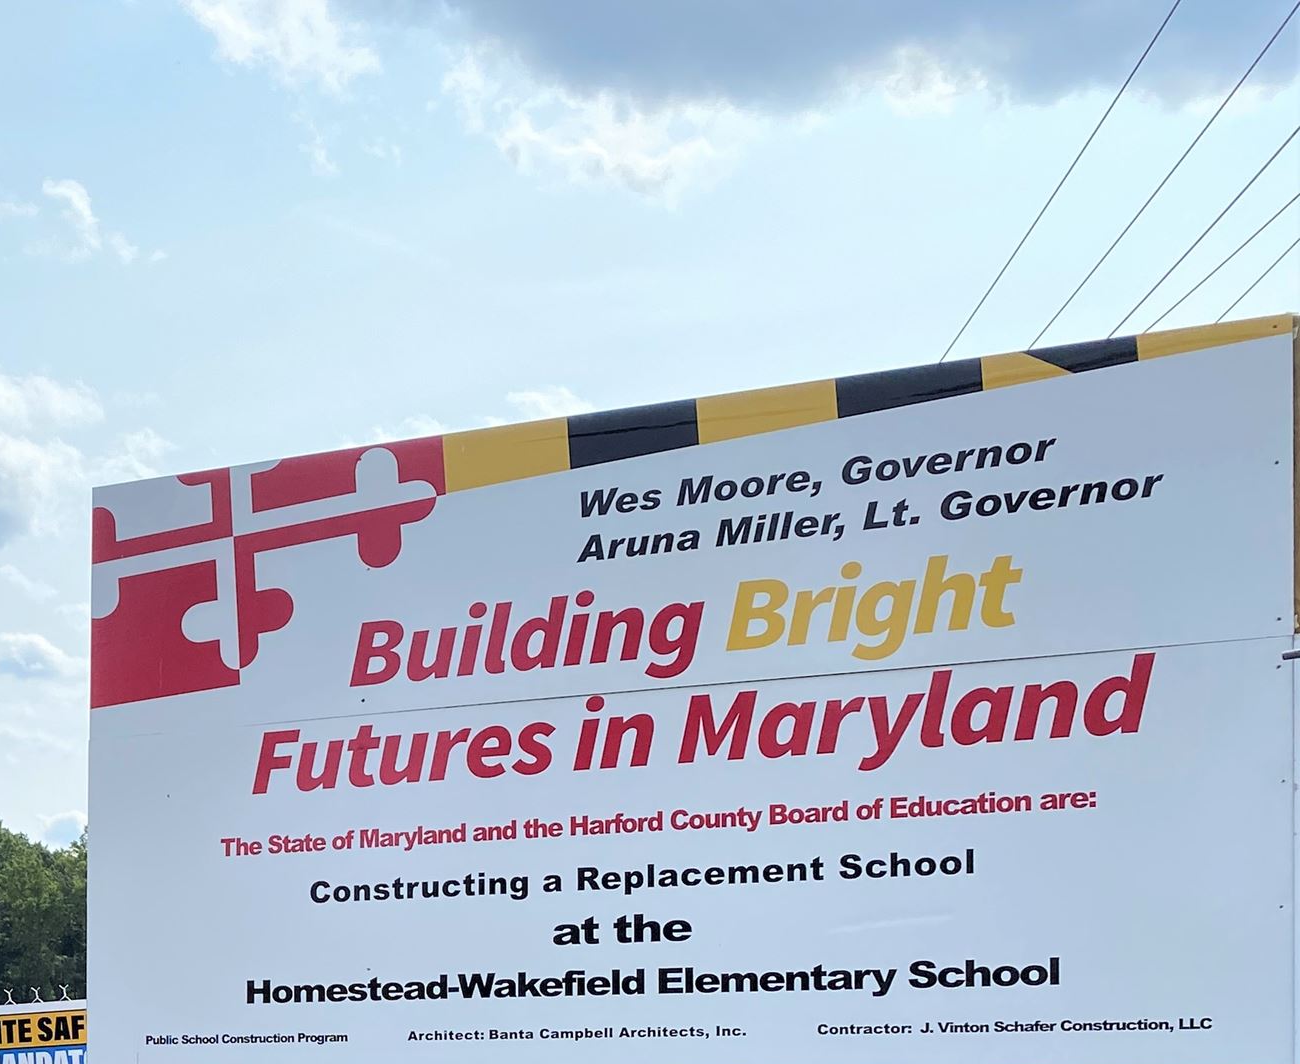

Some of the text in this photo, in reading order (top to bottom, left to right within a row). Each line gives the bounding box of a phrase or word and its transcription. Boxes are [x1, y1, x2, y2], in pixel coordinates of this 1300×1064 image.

[580, 437, 1058, 519] Wes Moore, Governor
[576, 473, 1165, 564] Aruna Miller, Lt. Governor
[349, 554, 1024, 687] Building Bright
[251, 652, 1157, 795] Futures in Maryland
[220, 791, 1097, 857] The State of Maryland and the Harford County Board of Education are:
[309, 848, 975, 904] Constructing a Replacement School
[552, 913, 693, 946] at the
[246, 956, 1060, 1005] Homestead-Wakefield Elementary School
[145, 1032, 349, 1045] Public School Construction Program
[407, 1025, 747, 1042] Architect: Banta Campbell Architects, Inc.
[817, 1017, 1213, 1035] Contractor: J. Vinton Schafer Construction, LLC
